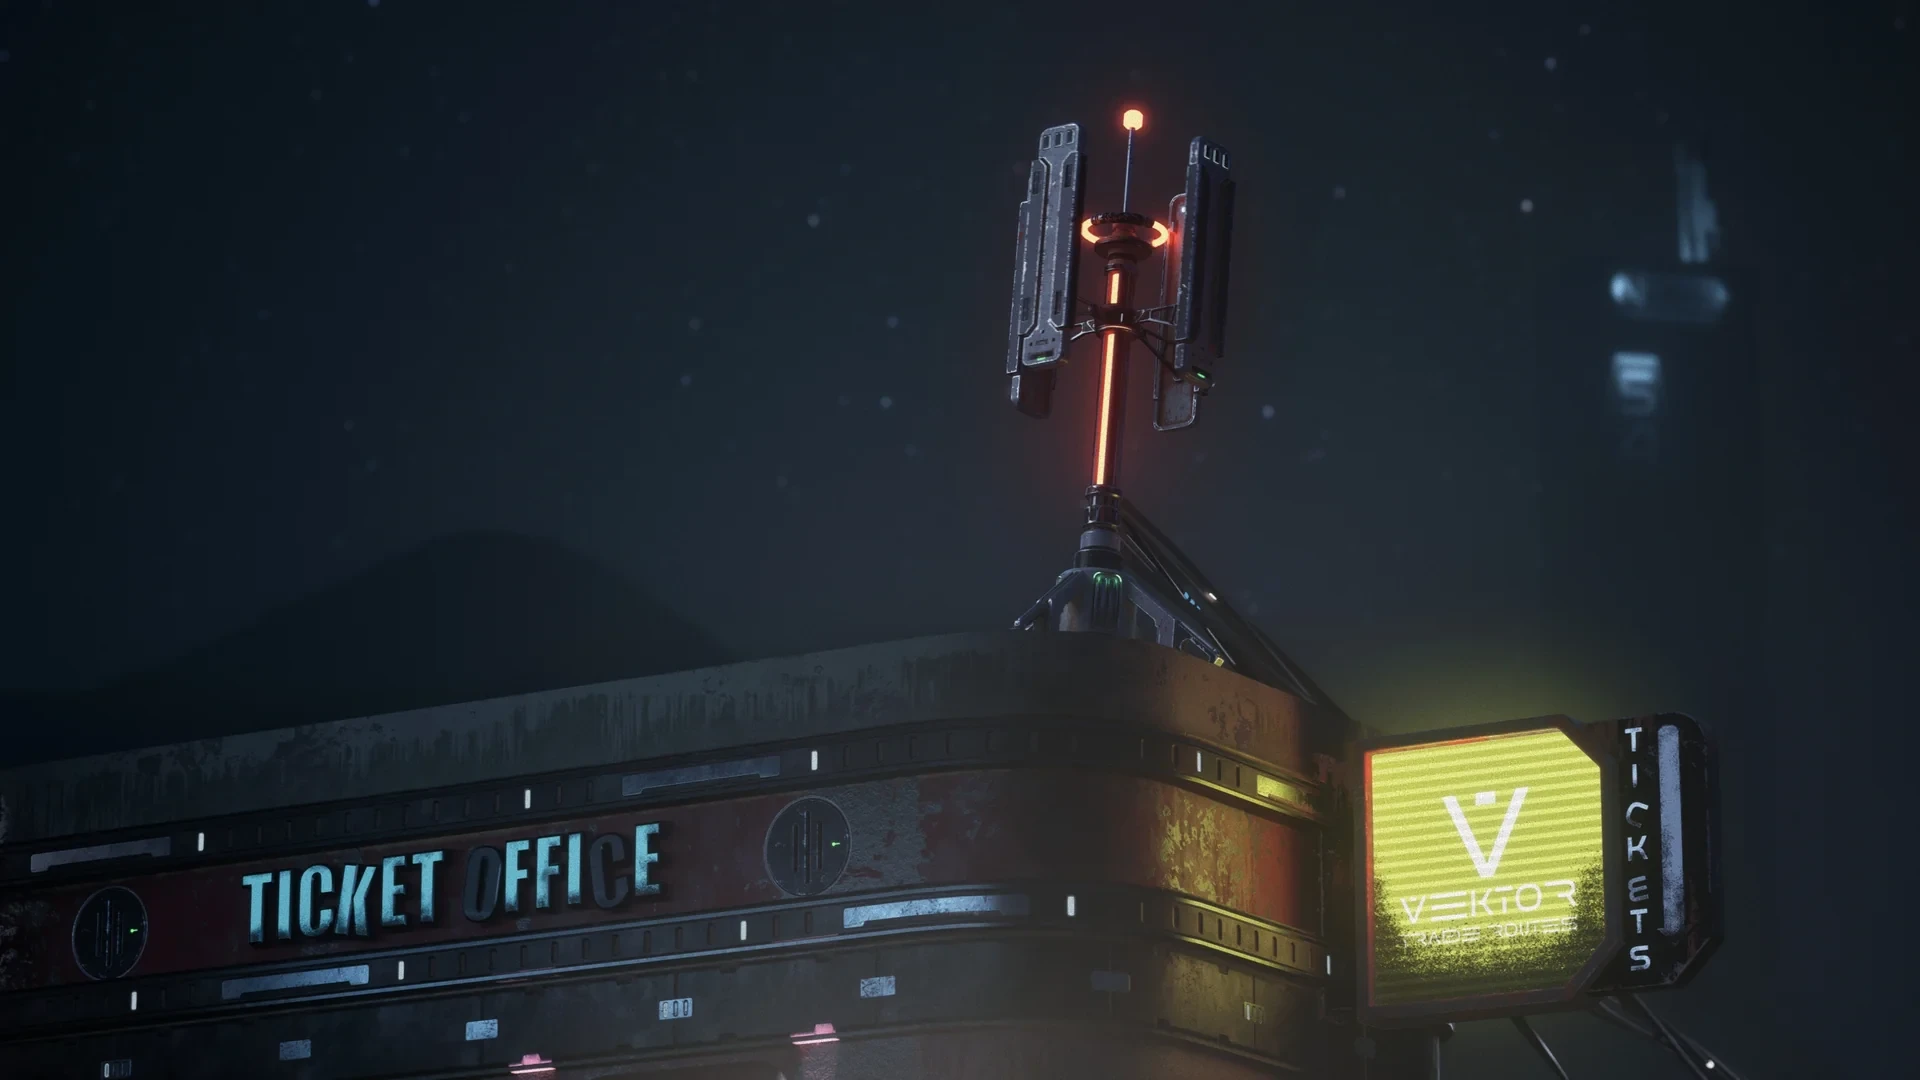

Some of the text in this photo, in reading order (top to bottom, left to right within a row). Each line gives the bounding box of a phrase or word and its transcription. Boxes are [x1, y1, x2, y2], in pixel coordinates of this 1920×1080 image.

[242, 822, 661, 945] TICKET OFFICE
[1400, 879, 1577, 924] VEKTOR
[1624, 727, 1651, 972] TICKETS
